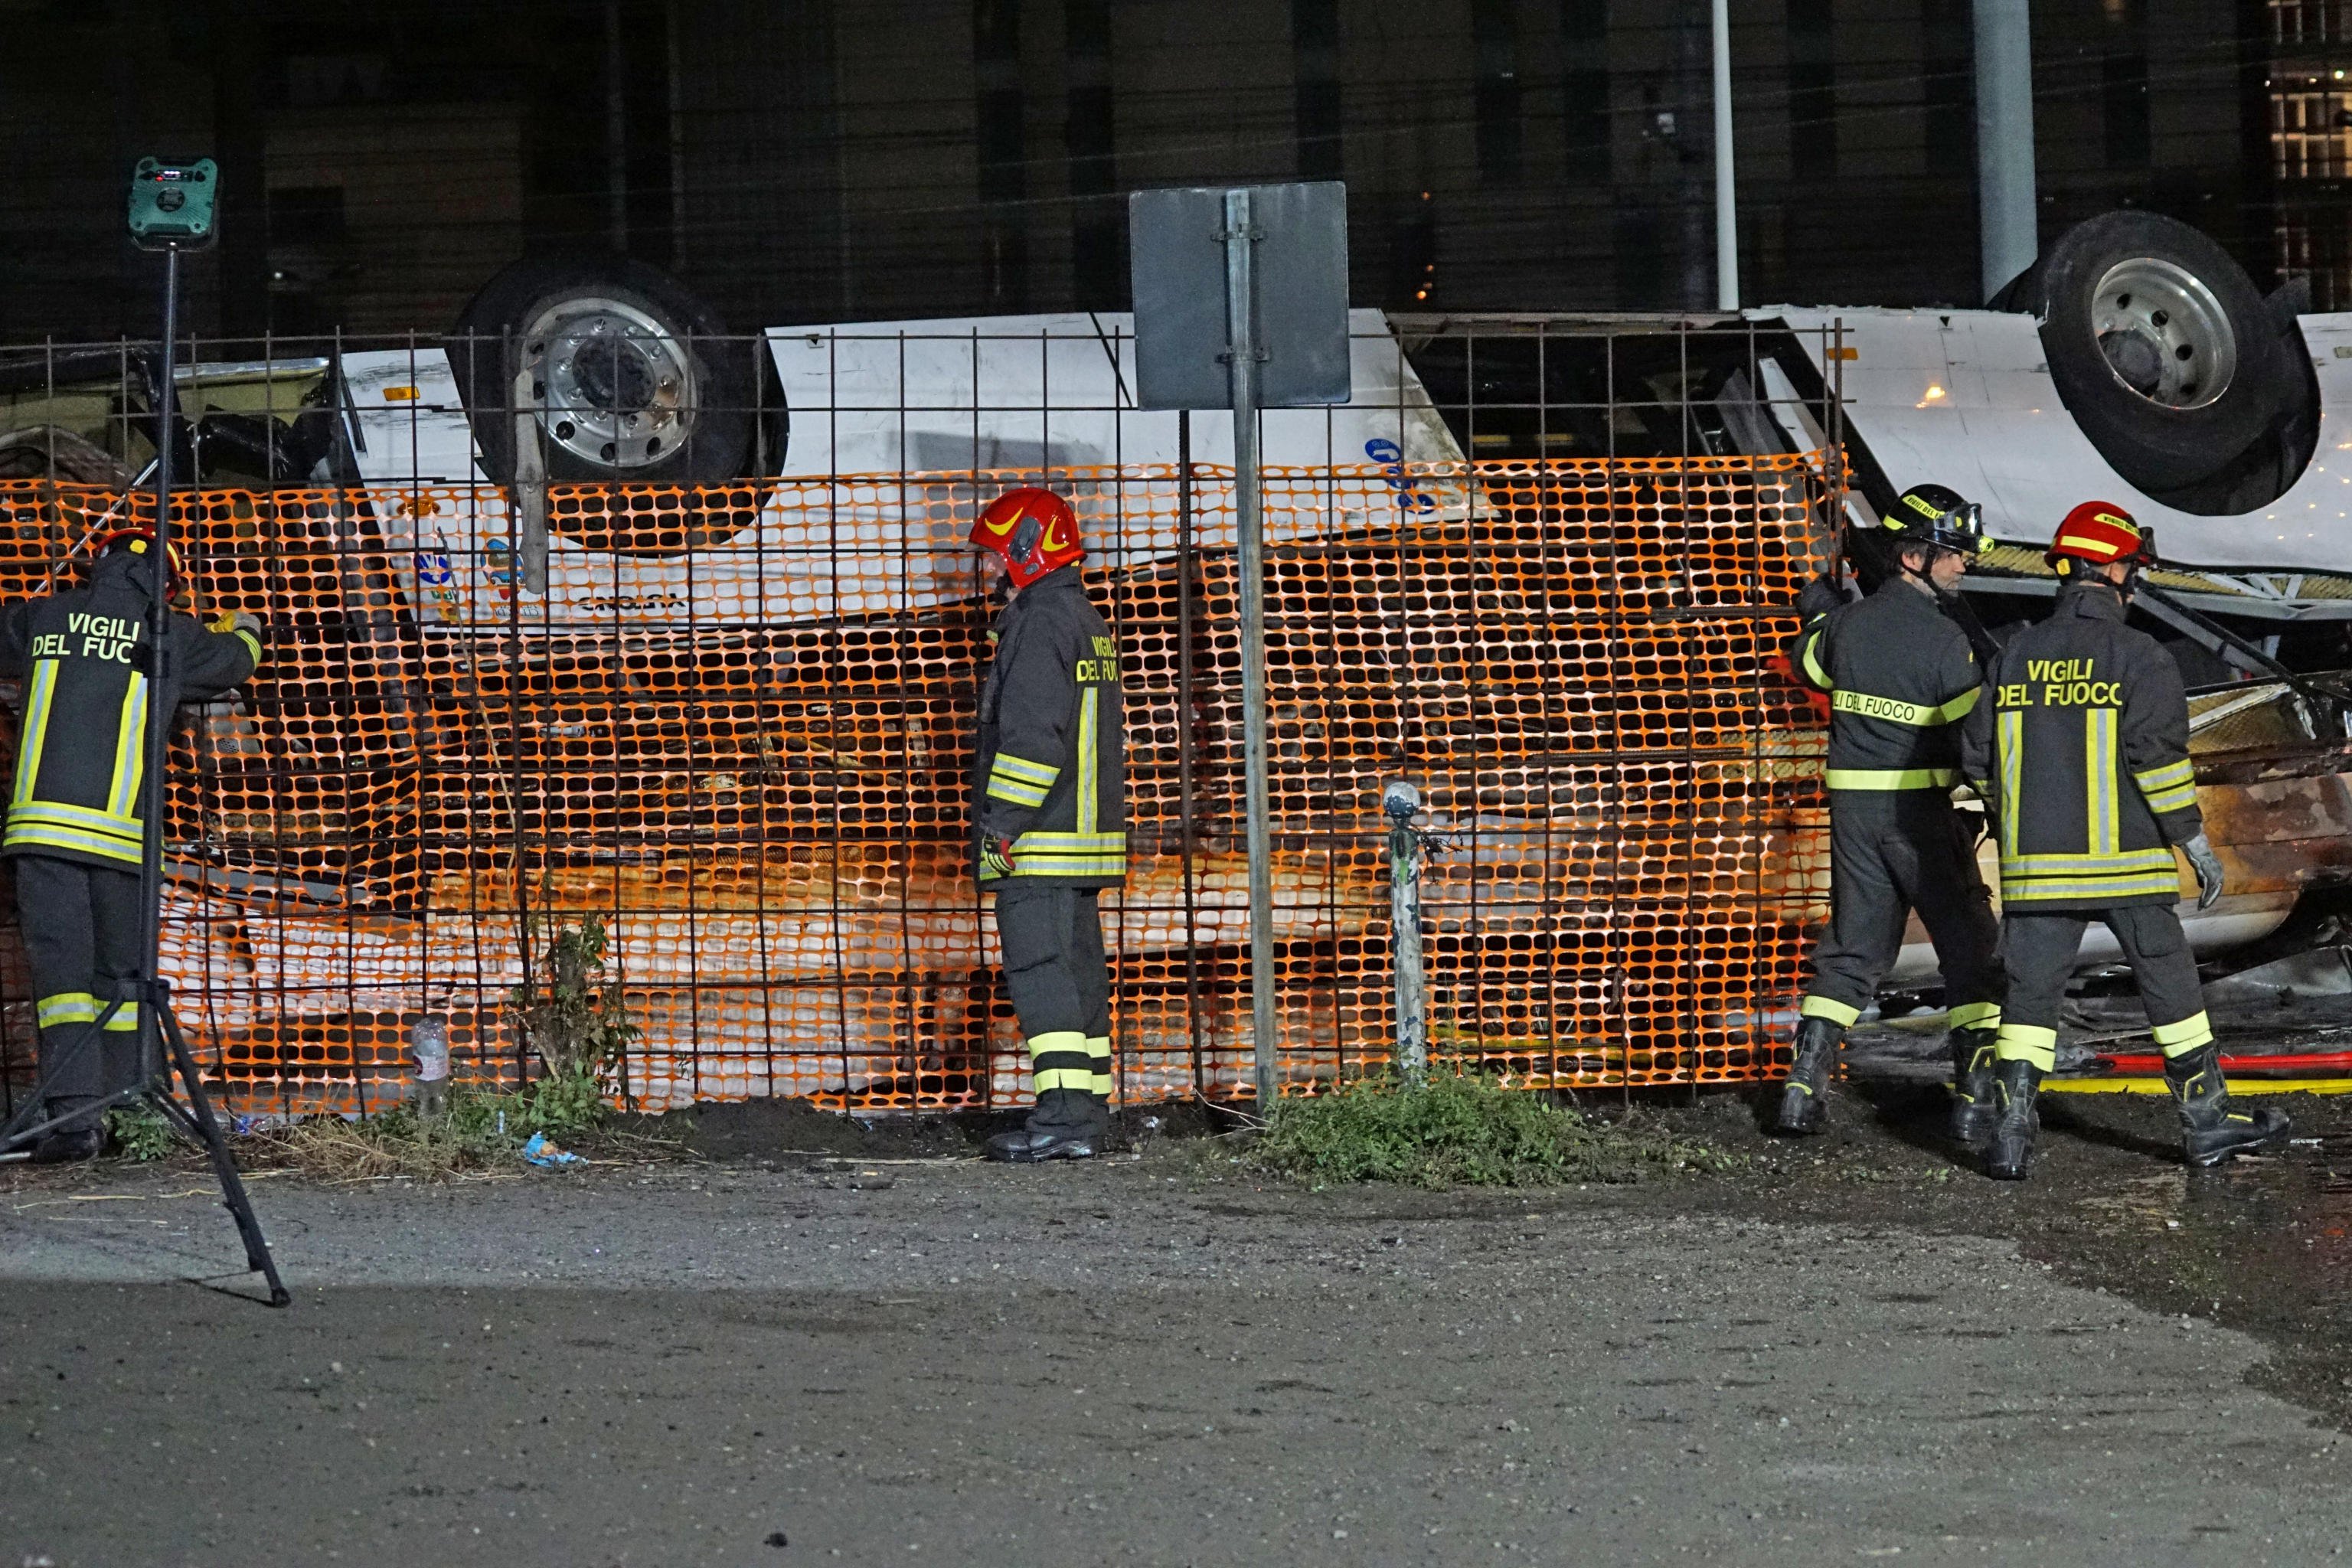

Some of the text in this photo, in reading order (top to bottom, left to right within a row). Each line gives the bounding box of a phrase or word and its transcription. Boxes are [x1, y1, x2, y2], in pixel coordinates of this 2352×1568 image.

[69, 612, 140, 642] VIGILI
[32, 635, 71, 657] DEL
[1076, 659, 1100, 681] DEL
[2027, 658, 2094, 682] VIGILI
[1845, 694, 1861, 710] DEL
[1864, 697, 1915, 721] FUOCO
